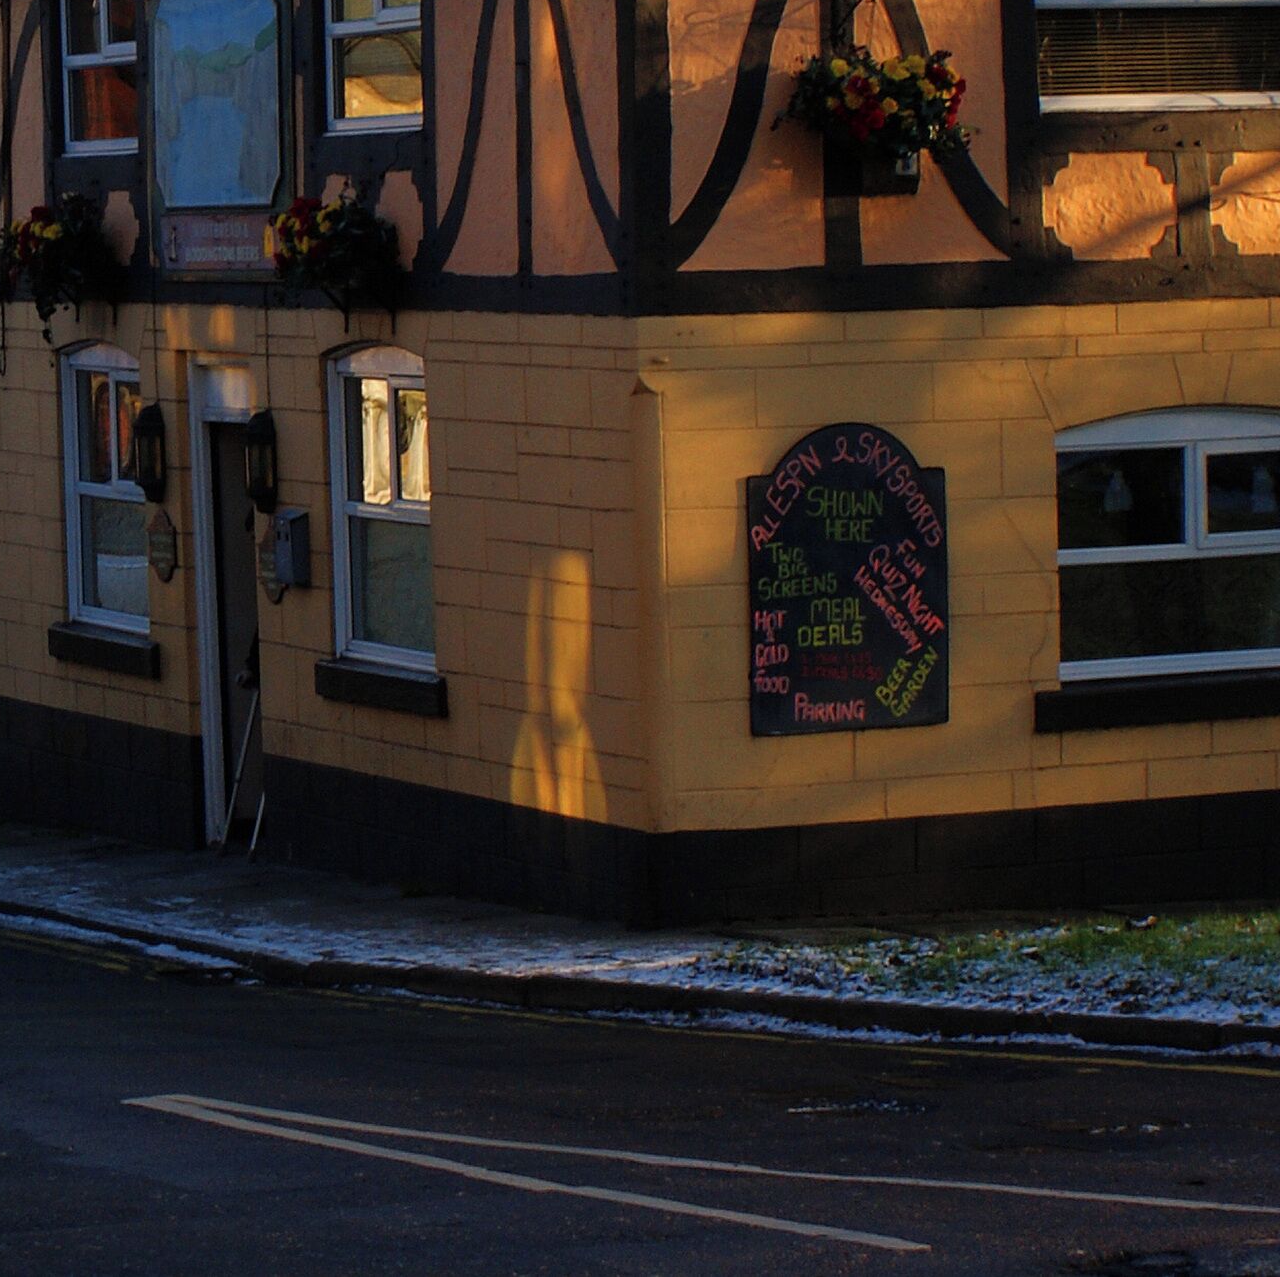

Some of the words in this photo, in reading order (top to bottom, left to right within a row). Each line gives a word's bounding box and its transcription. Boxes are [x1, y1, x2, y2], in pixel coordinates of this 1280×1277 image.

[766, 444, 822, 517] ESPN
[832, 436, 855, 463] &
[856, 432, 901, 478] SKY
[886, 464, 944, 548] SPORTS
[806, 486, 885, 518] SHOWN
[825, 518, 874, 543] HERE
[757, 573, 837, 600] SCREENS
[754, 610, 787, 631] HOT
[810, 597, 866, 624] MEAL
[797, 624, 863, 647] DEALS
[875, 658, 912, 707] BEER
[890, 645, 938, 718] GARDEN
[794, 692, 866, 722] PARKING
